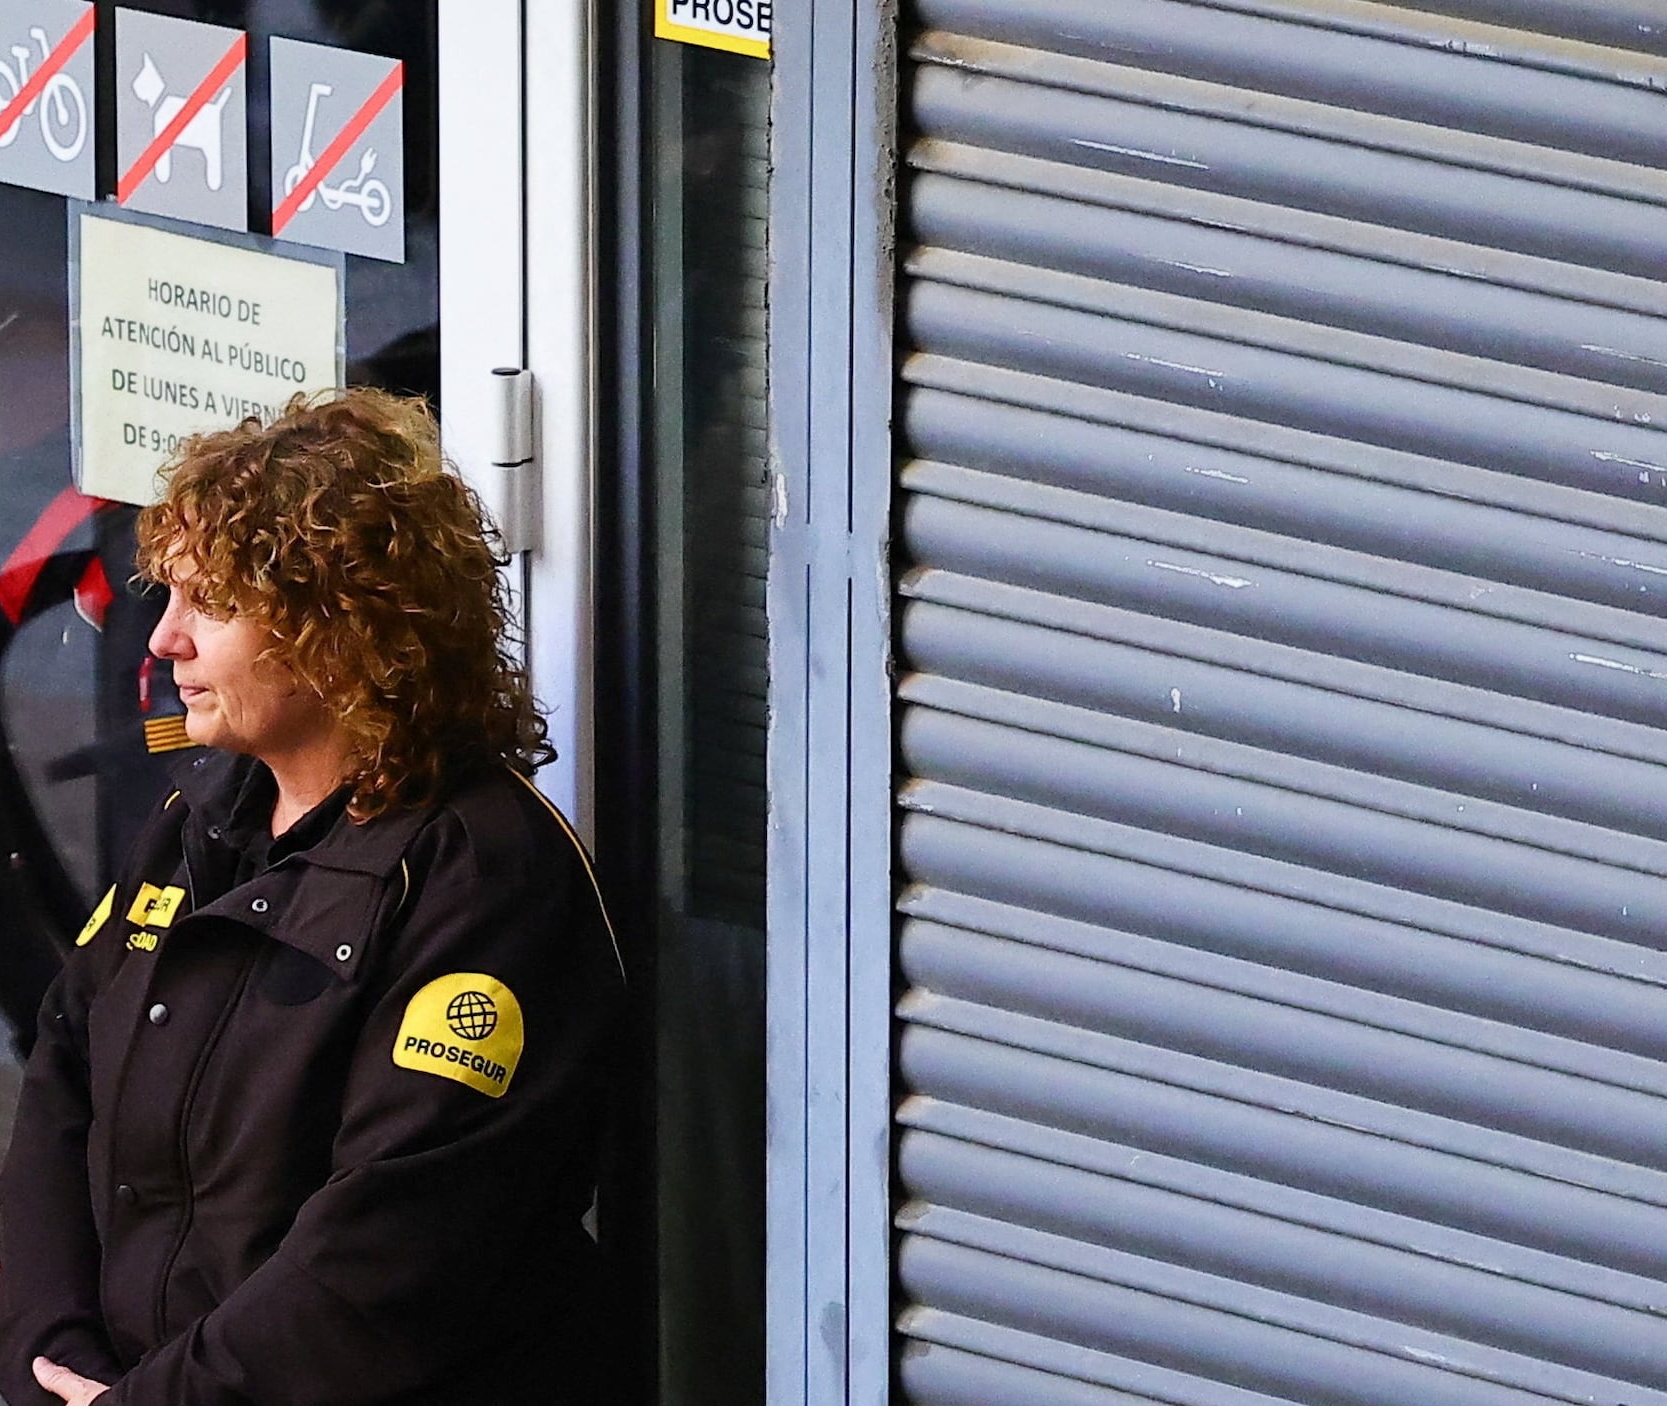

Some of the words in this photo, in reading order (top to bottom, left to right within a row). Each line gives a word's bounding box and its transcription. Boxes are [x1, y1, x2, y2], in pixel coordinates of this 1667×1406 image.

[148, 278, 232, 319] HORARIO
[238, 299, 262, 326] DE
[101, 316, 196, 357] ATENCIÓN
[201, 339, 223, 364] AL
[229, 342, 307, 383] PÚBLICO
[112, 368, 138, 394] DE
[143, 375, 200, 409] LUNES
[205, 391, 218, 415] A
[123, 423, 147, 449] DE
[404, 1036, 507, 1085] PROSEGUR
